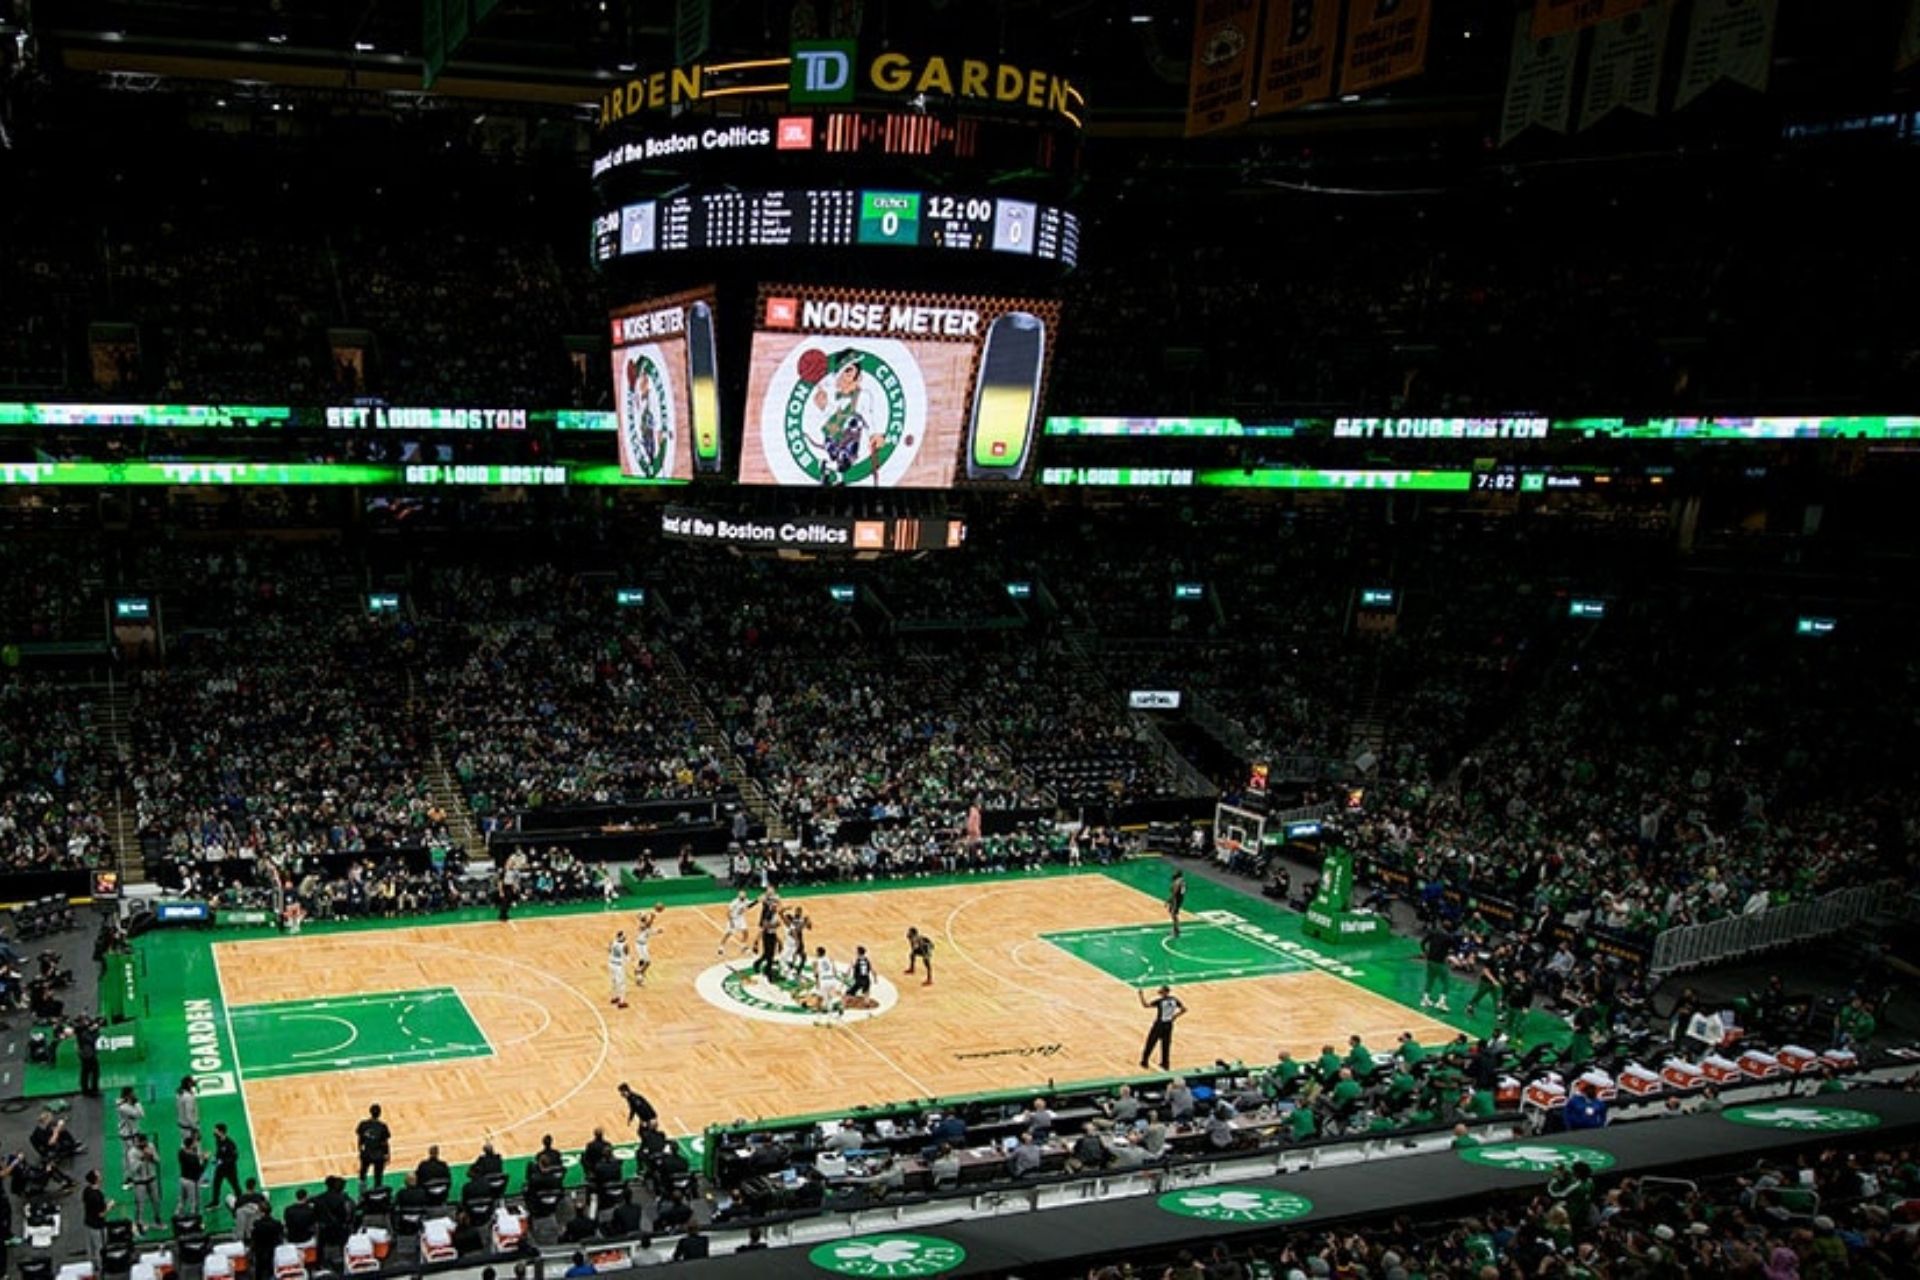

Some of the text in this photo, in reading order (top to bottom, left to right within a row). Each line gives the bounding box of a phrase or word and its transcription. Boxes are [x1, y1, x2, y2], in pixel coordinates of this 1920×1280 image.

[796, 51, 1070, 112] TD GARDEN
[646, 134, 698, 159] Boston
[702, 125, 770, 149] Celtics
[927, 197, 991, 222] 12:00
[881, 211, 898, 236] 0
[802, 300, 883, 331] NOISE
[888, 306, 979, 335] METER
[326, 408, 370, 428] GET
[787, 365, 904, 469] BOSTON CELTICS
[405, 466, 439, 484] GET
[1477, 474, 1515, 489] 7:02
[718, 522, 774, 541] Boston
[779, 524, 848, 544] Celtics
[183, 998, 222, 1072] GARDEN
